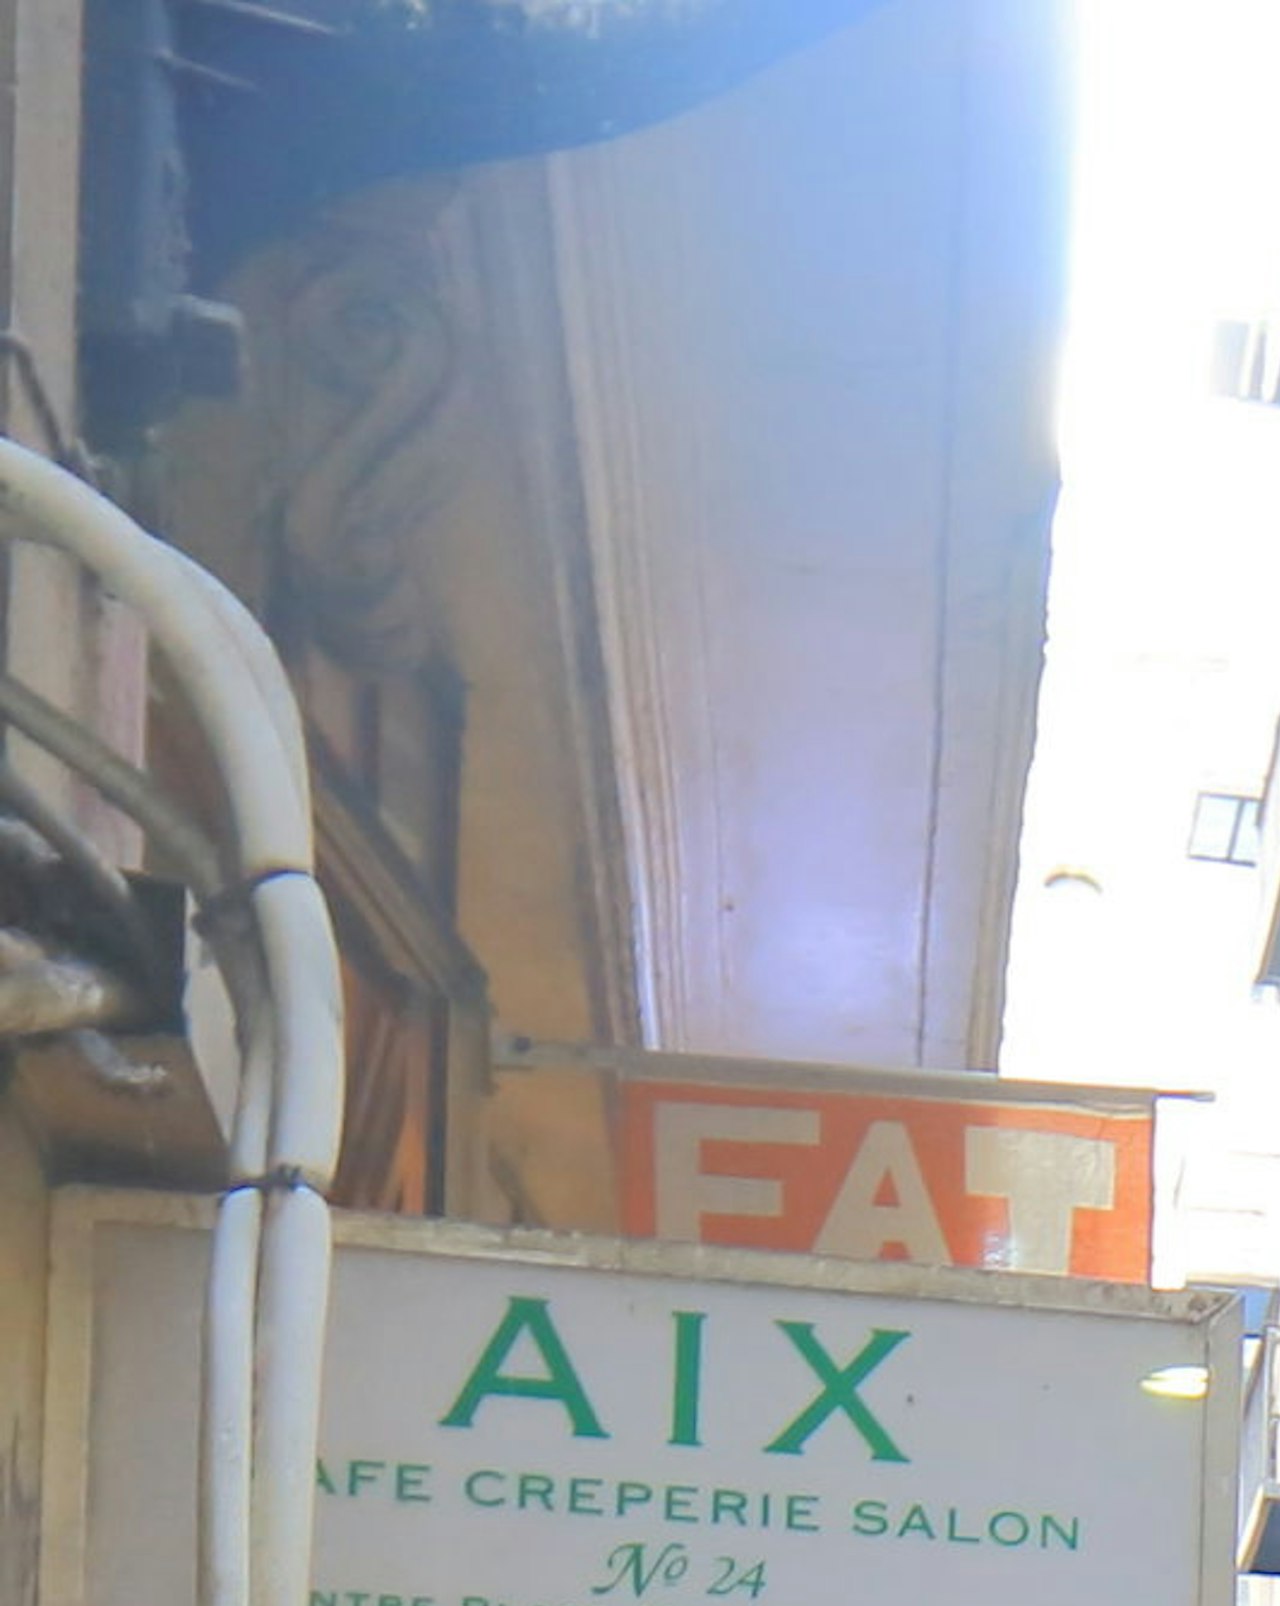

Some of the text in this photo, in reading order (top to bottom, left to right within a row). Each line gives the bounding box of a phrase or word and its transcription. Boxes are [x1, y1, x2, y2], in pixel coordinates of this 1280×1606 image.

[438, 1295, 911, 1463] AIX
[464, 1469, 820, 1532] CREPERIE
[852, 1500, 1079, 1551] SALON
[706, 1556, 767, 1600] 24
